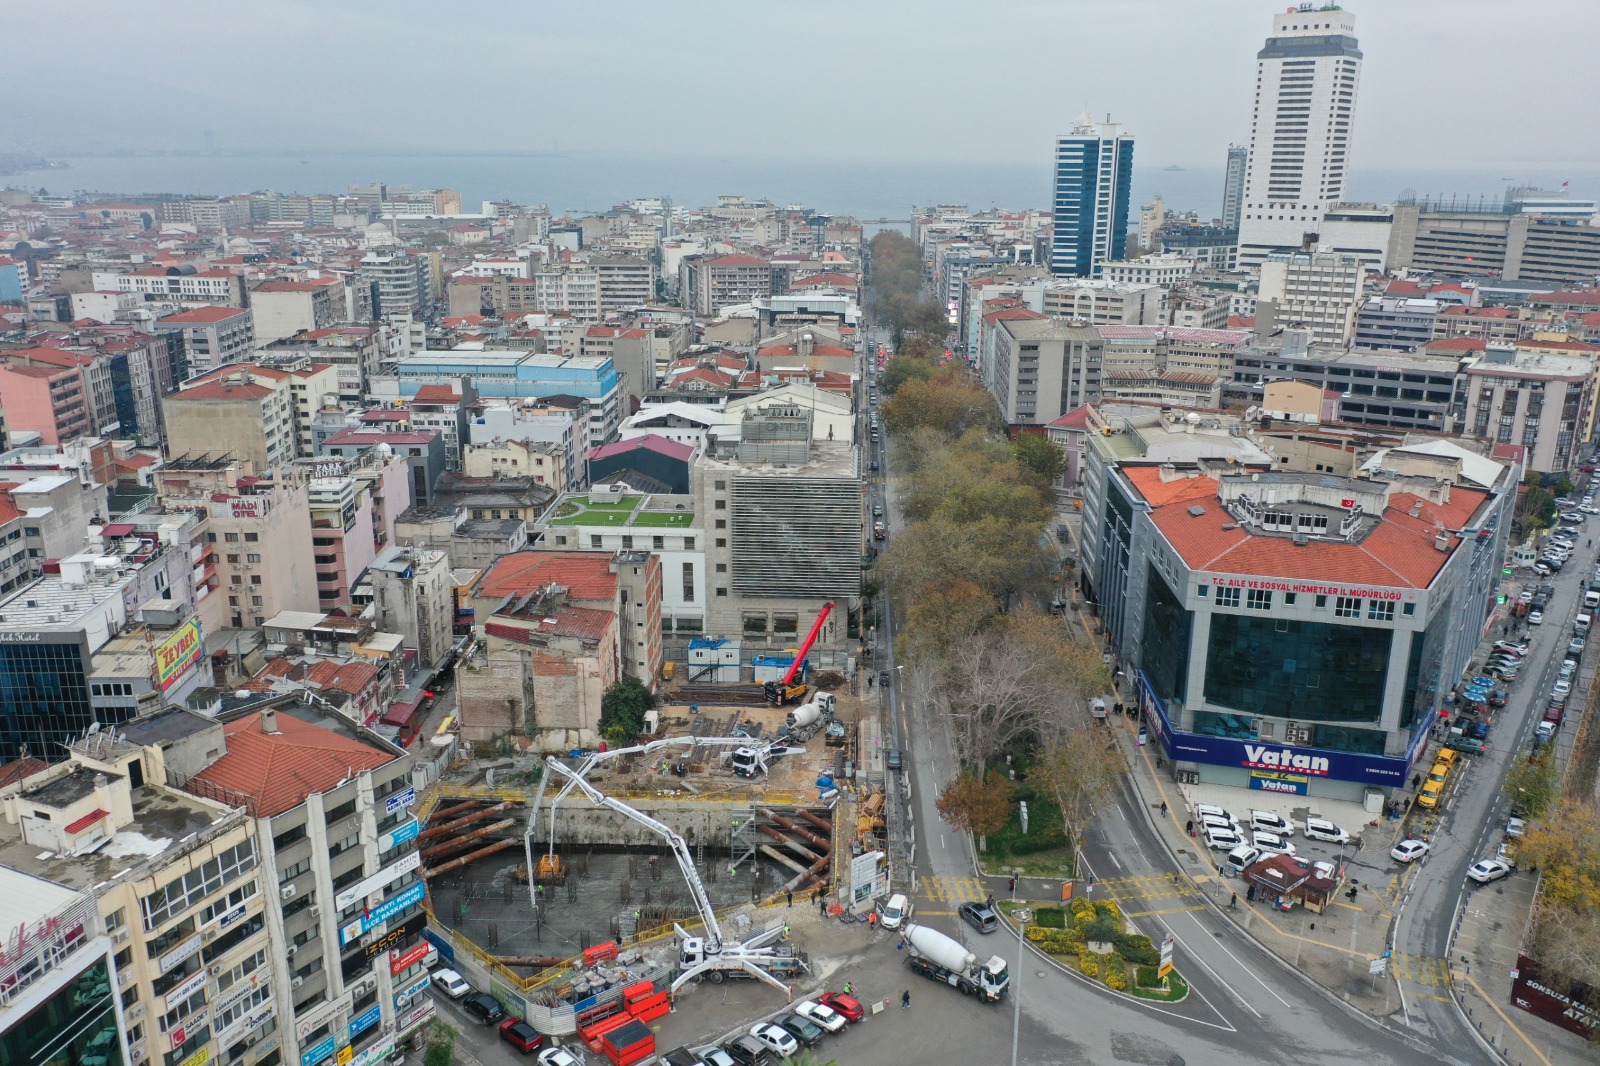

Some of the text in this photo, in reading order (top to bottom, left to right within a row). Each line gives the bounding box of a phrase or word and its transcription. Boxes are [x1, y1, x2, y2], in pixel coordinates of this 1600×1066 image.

[315, 469, 345, 478] HOTEL
[316, 462, 342, 471] PARK
[1212, 577, 1226, 586] T.C.
[1228, 578, 1246, 588] AİLE
[1260, 581, 1290, 592] SOSYAL
[1293, 583, 1339, 596] HİZMETLER
[1340, 587, 1347, 596] İL
[1350, 588, 1402, 600] MÜDÜRLÜĞÜ
[162, 629, 195, 669] ZEYBEK
[1243, 744, 1329, 771] Vatan
[1248, 761, 1321, 775] COMPUTER
[1261, 779, 1297, 792] Vatan
[396, 886, 420, 903] KONAK
[1525, 980, 1570, 1004] SONSUZA
[185, 1010, 208, 1031] SAADET
[250, 1006, 273, 1029] patent
